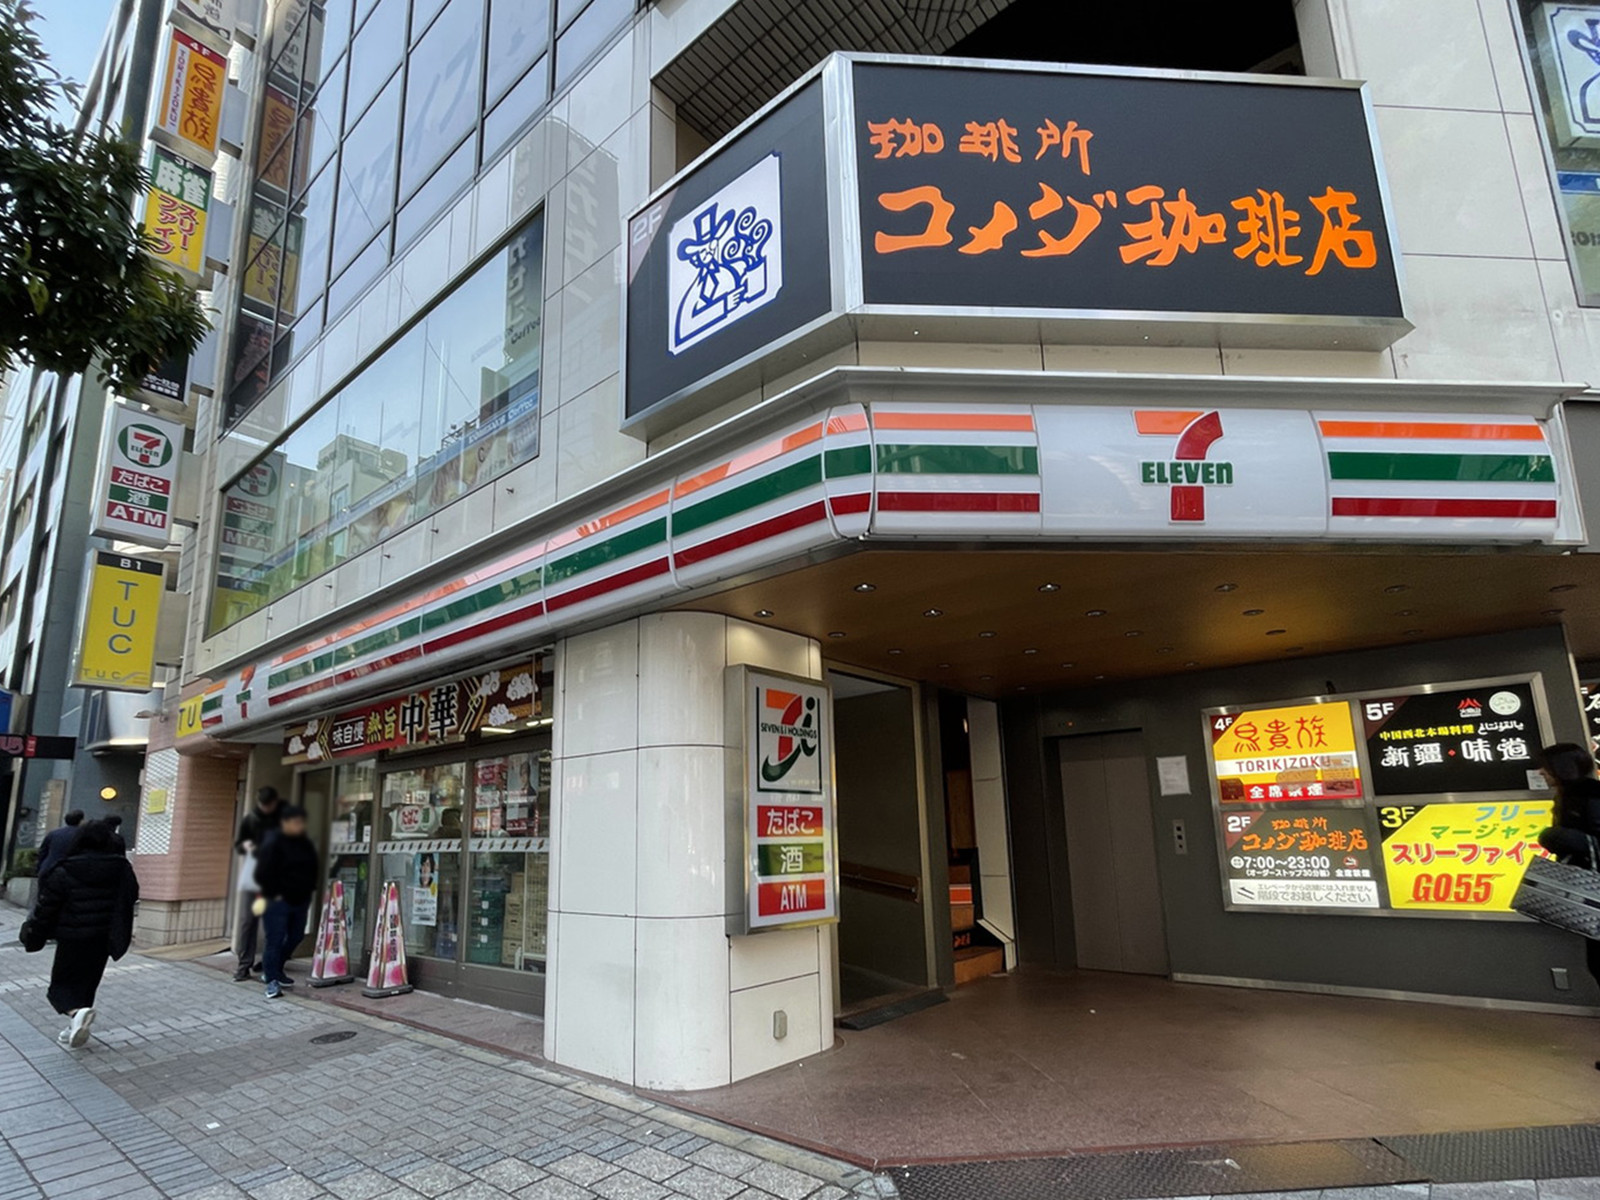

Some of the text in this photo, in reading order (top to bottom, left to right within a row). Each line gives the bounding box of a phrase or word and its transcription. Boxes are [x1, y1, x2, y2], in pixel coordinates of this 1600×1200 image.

[190, 41, 211, 58] 4F
[867, 117, 1094, 175] 珈琲所
[174, 156, 195, 170] 3F
[155, 159, 207, 209] 麻雀
[178, 203, 199, 250] スリー
[633, 204, 662, 246] 2F
[875, 182, 1378, 276] コメダ珈琲店
[1133, 409, 1223, 521] 7
[118, 470, 165, 493] たばこ
[127, 489, 151, 506] 酒
[111, 507, 164, 527] ATM
[120, 558, 142, 571] B1
[108, 579, 139, 654] TUC
[179, 702, 203, 731] TU
[400, 683, 460, 745] 中華
[1366, 702, 1394, 721] 5F
[1214, 717, 1233, 731] 4F
[1234, 716, 1327, 753] 鳥貴族
[1236, 756, 1330, 773] TORIKIZOKU
[766, 809, 816, 835] たばこ
[1227, 815, 1251, 832] 2F
[1381, 806, 1415, 828] 3F
[1475, 805, 1546, 822] フリー
[1242, 828, 1368, 851] コメダ珈琲店
[1430, 823, 1548, 840] マージャン
[781, 846, 803, 873] 酒
[780, 884, 808, 911] ATM
